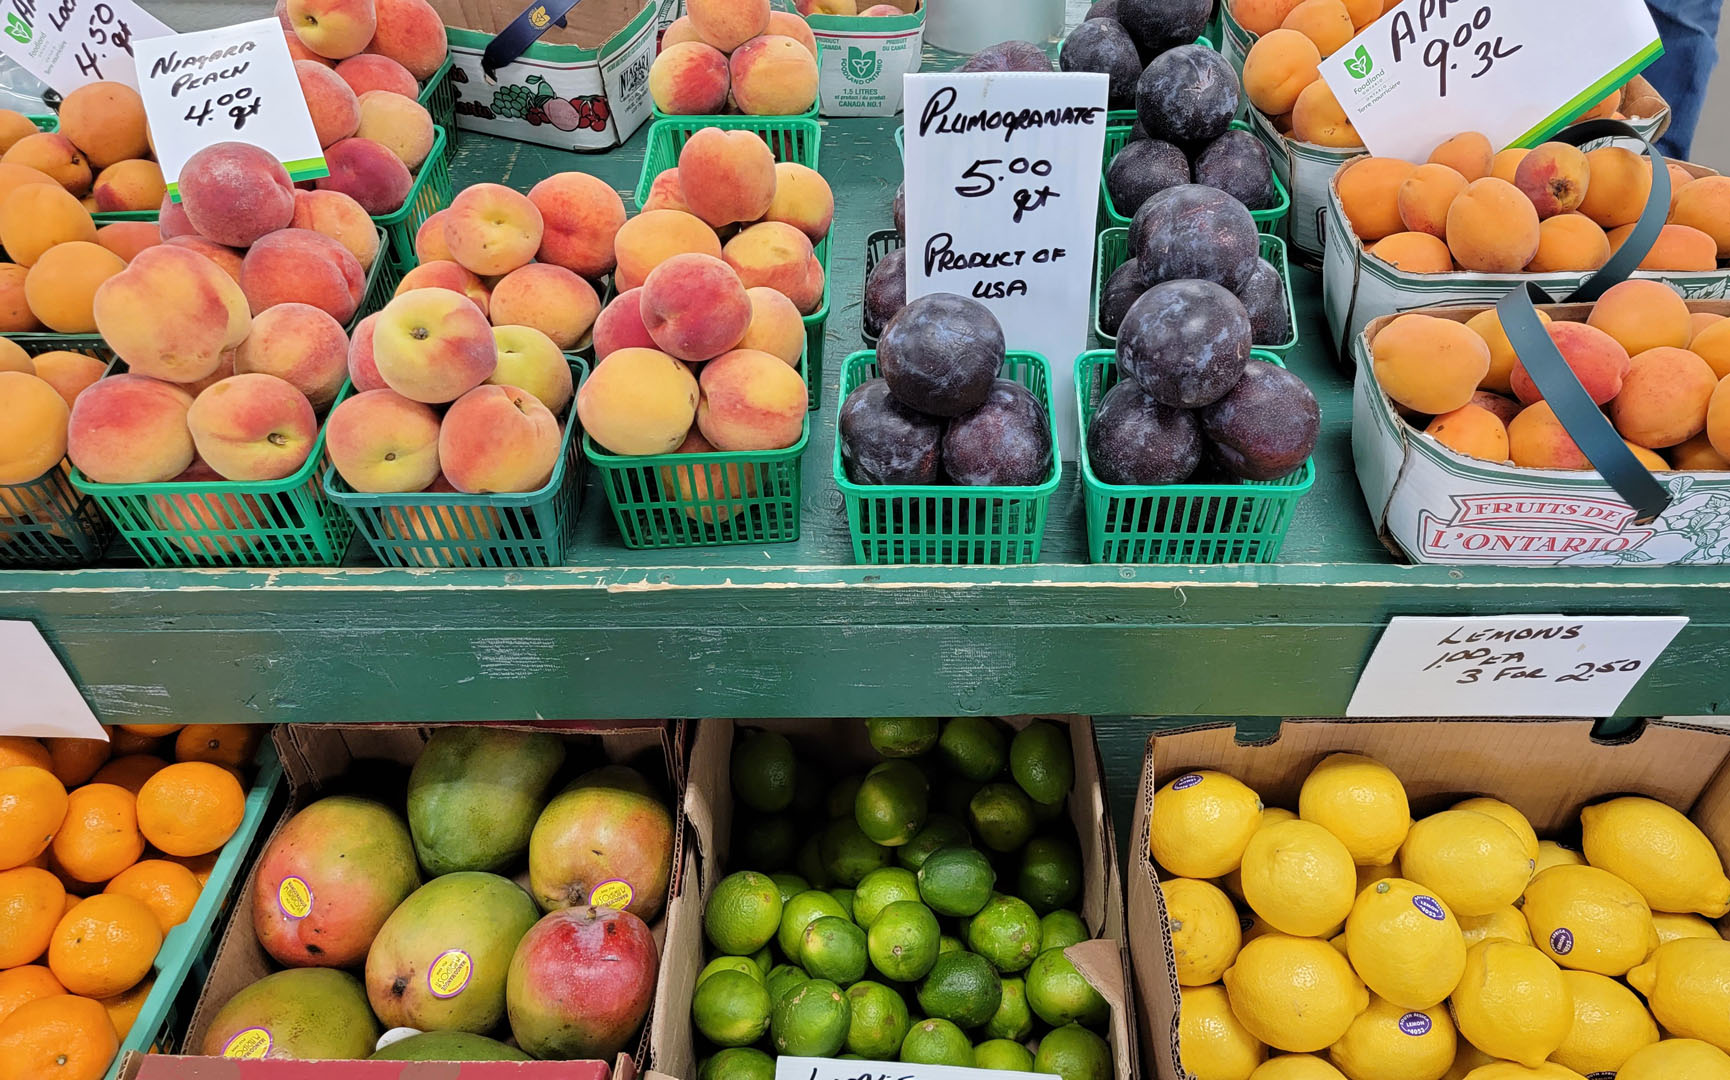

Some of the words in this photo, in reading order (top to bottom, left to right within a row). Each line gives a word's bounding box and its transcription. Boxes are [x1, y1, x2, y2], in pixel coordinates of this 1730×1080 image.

[150, 41, 256, 79] NIAGARA
[1423, 6, 1491, 97] 9.00
[1471, 37, 1523, 78] 3L
[171, 62, 250, 97] PEACH
[841, 58, 864, 85] FOODLAND
[865, 58, 883, 84] ONTARIO
[1354, 68, 1385, 95] Foodland
[184, 87, 252, 127] 4.00
[229, 97, 261, 130] qt
[839, 100, 865, 108] CANADA
[919, 86, 1105, 142] PLUMOGRANATE
[955, 157, 1052, 197] 5.00
[1013, 186, 1060, 223] qt
[924, 232, 1026, 277] PRODUCT
[1032, 248, 1066, 263] OF
[972, 280, 1027, 299] USA
[1474, 502, 1580, 516] FRUITS
[1582, 506, 1623, 522] DE
[1429, 529, 1630, 552] L'ONTARIO
[1437, 625, 1583, 646] LEMONS
[1456, 668, 1483, 684] 3
[1555, 659, 1641, 682] 2.50
[1421, 900, 1439, 912] LEMON
[1557, 935, 1566, 950] LEMON
